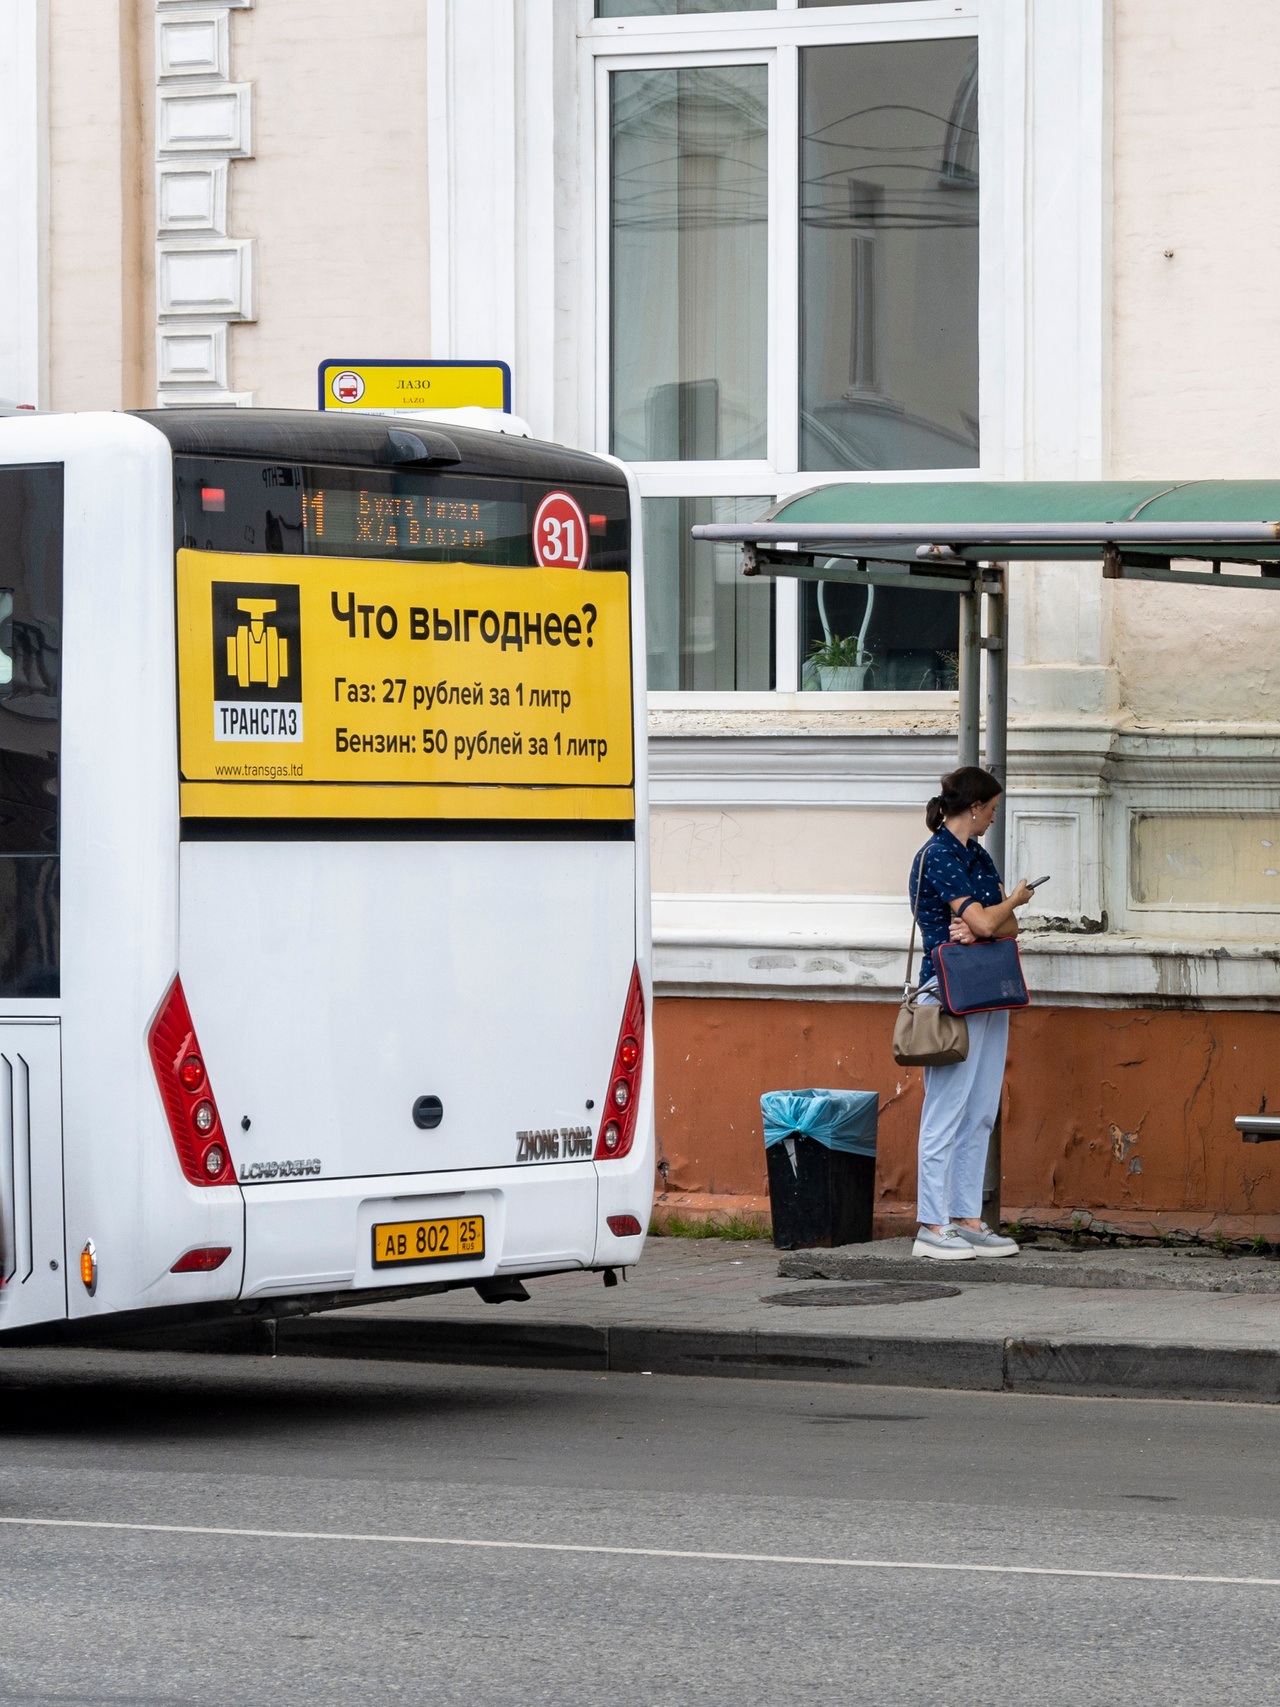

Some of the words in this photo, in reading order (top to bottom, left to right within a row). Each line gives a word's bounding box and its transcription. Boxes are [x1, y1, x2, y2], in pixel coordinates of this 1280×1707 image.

[396, 380, 431, 390] ЛАЗО
[542, 517, 579, 562] 31
[331, 591, 398, 640] Что
[409, 603, 597, 652] выгоднее?
[334, 677, 376, 703] Газ:
[382, 678, 407, 703] 27
[413, 680, 484, 710] рублей
[489, 687, 510, 706] за
[515, 682, 524, 706] 1
[529, 689, 571, 713] литр
[220, 707, 297, 735] ТРАНСГАЗ
[335, 727, 416, 753] Бензин:
[422, 729, 448, 753] 50
[454, 730, 523, 760] рублей
[528, 737, 548, 755] за
[553, 731, 562, 755] 1
[566, 738, 608, 762] литр
[215, 763, 304, 779] www.transgas.ltd
[515, 1129, 560, 1162] ZHONG
[560, 1126, 593, 1158] TONG
[416, 1225, 449, 1253] 802
[460, 1221, 476, 1242] 25
[461, 1242, 475, 1251] RUS
